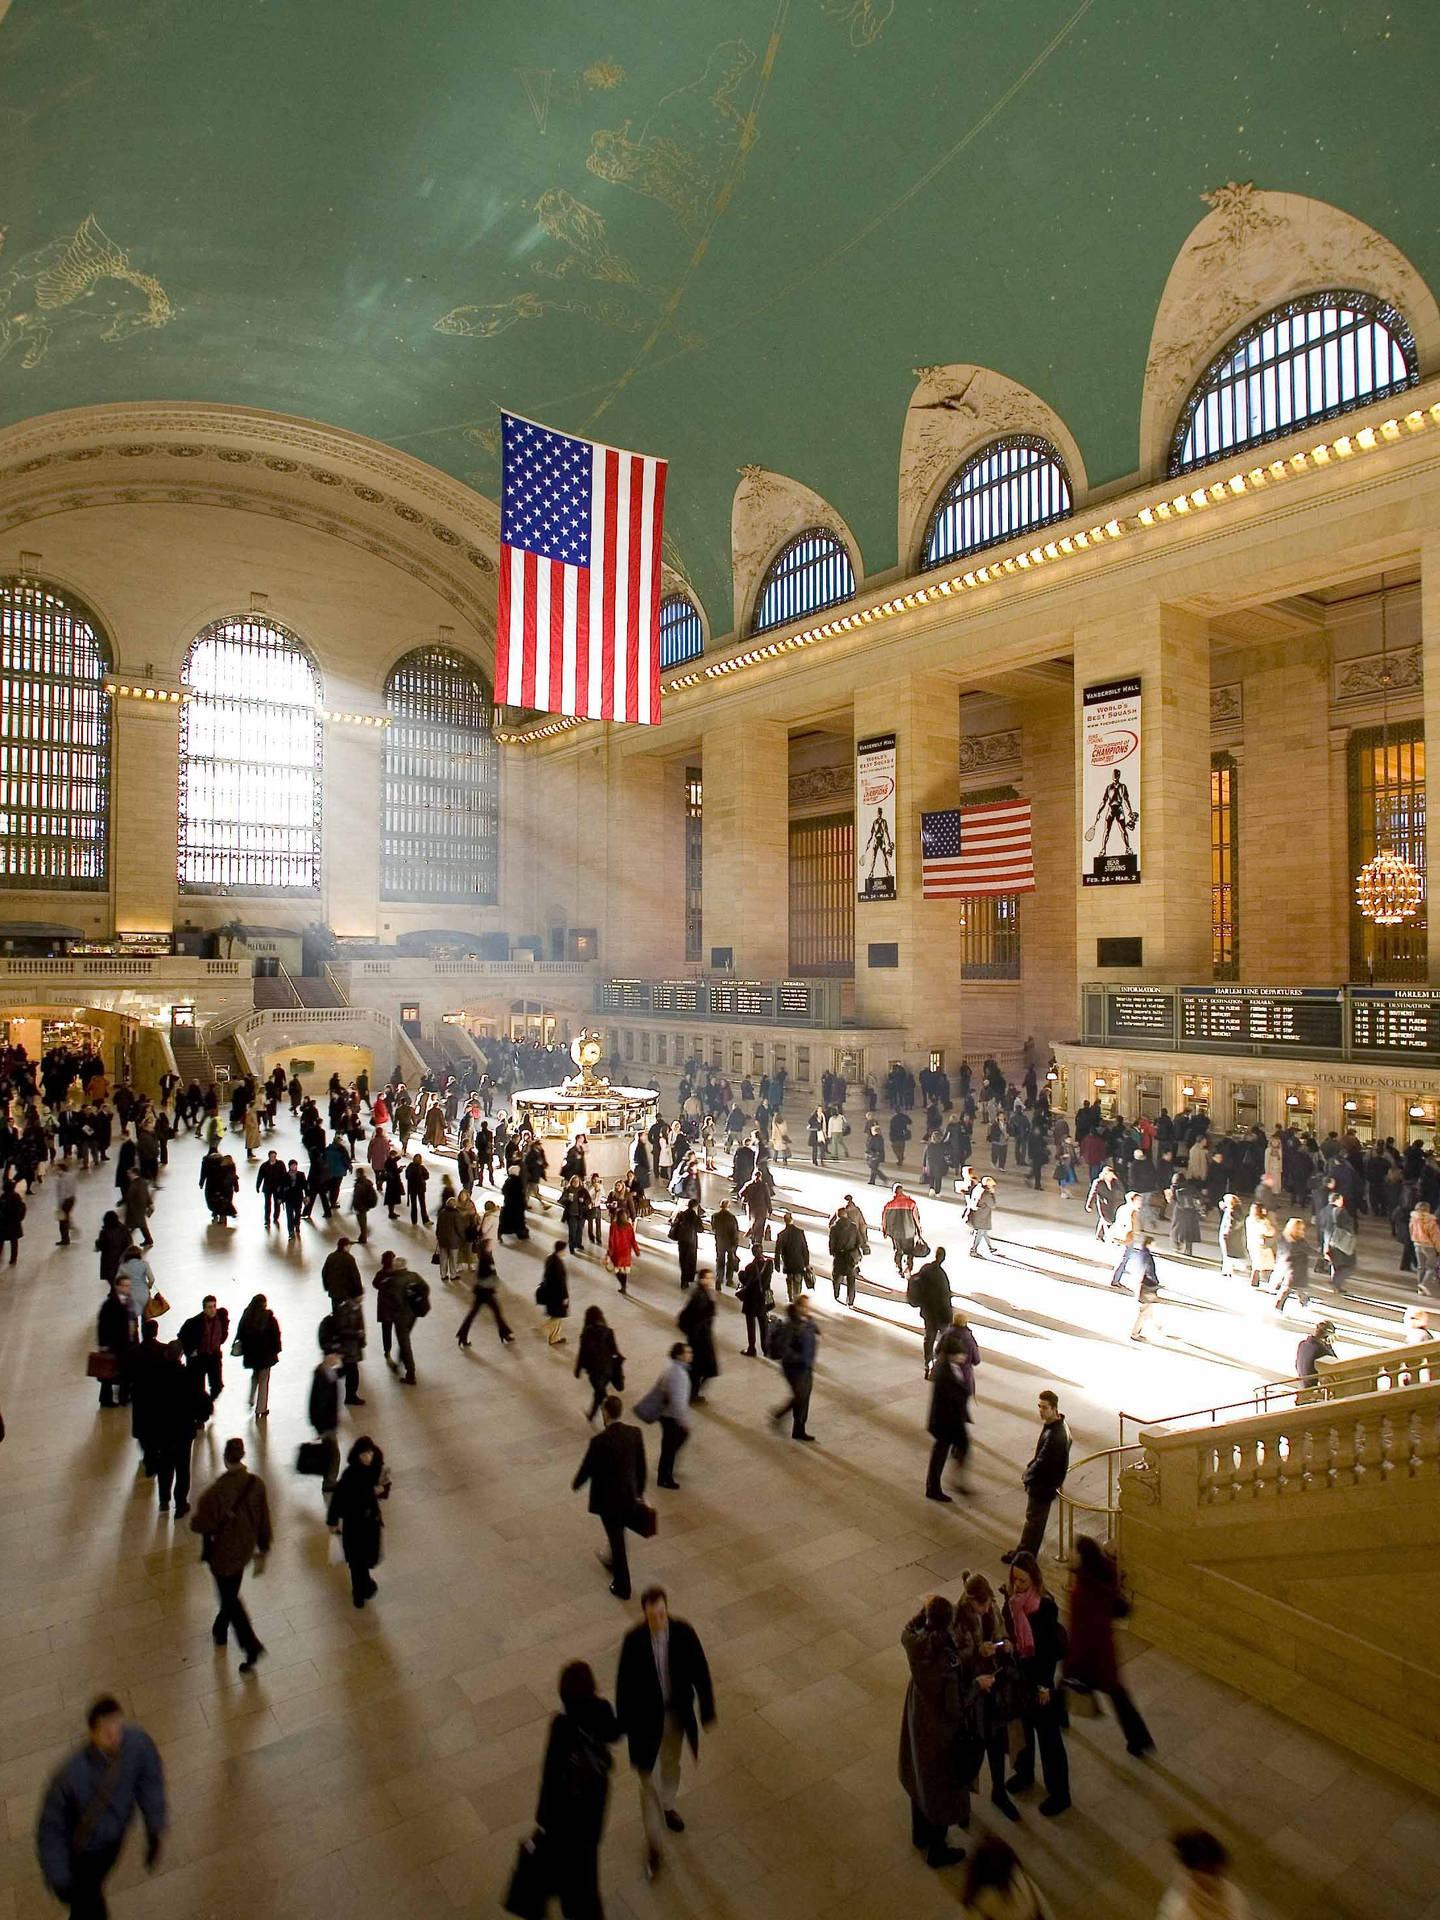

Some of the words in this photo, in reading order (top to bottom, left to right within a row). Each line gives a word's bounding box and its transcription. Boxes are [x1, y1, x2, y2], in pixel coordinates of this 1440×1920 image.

[1086, 688, 1121, 699] VANDERBILT
[1123, 684, 1140, 693] HALL
[1096, 702, 1128, 713] WORLD'S
[1108, 709, 1137, 719] SQUASH
[1092, 744, 1128, 757] CHAMPIONS
[1313, 1073, 1335, 1082] MTA
[1337, 1075, 1416, 1089] METRO-NORTH
